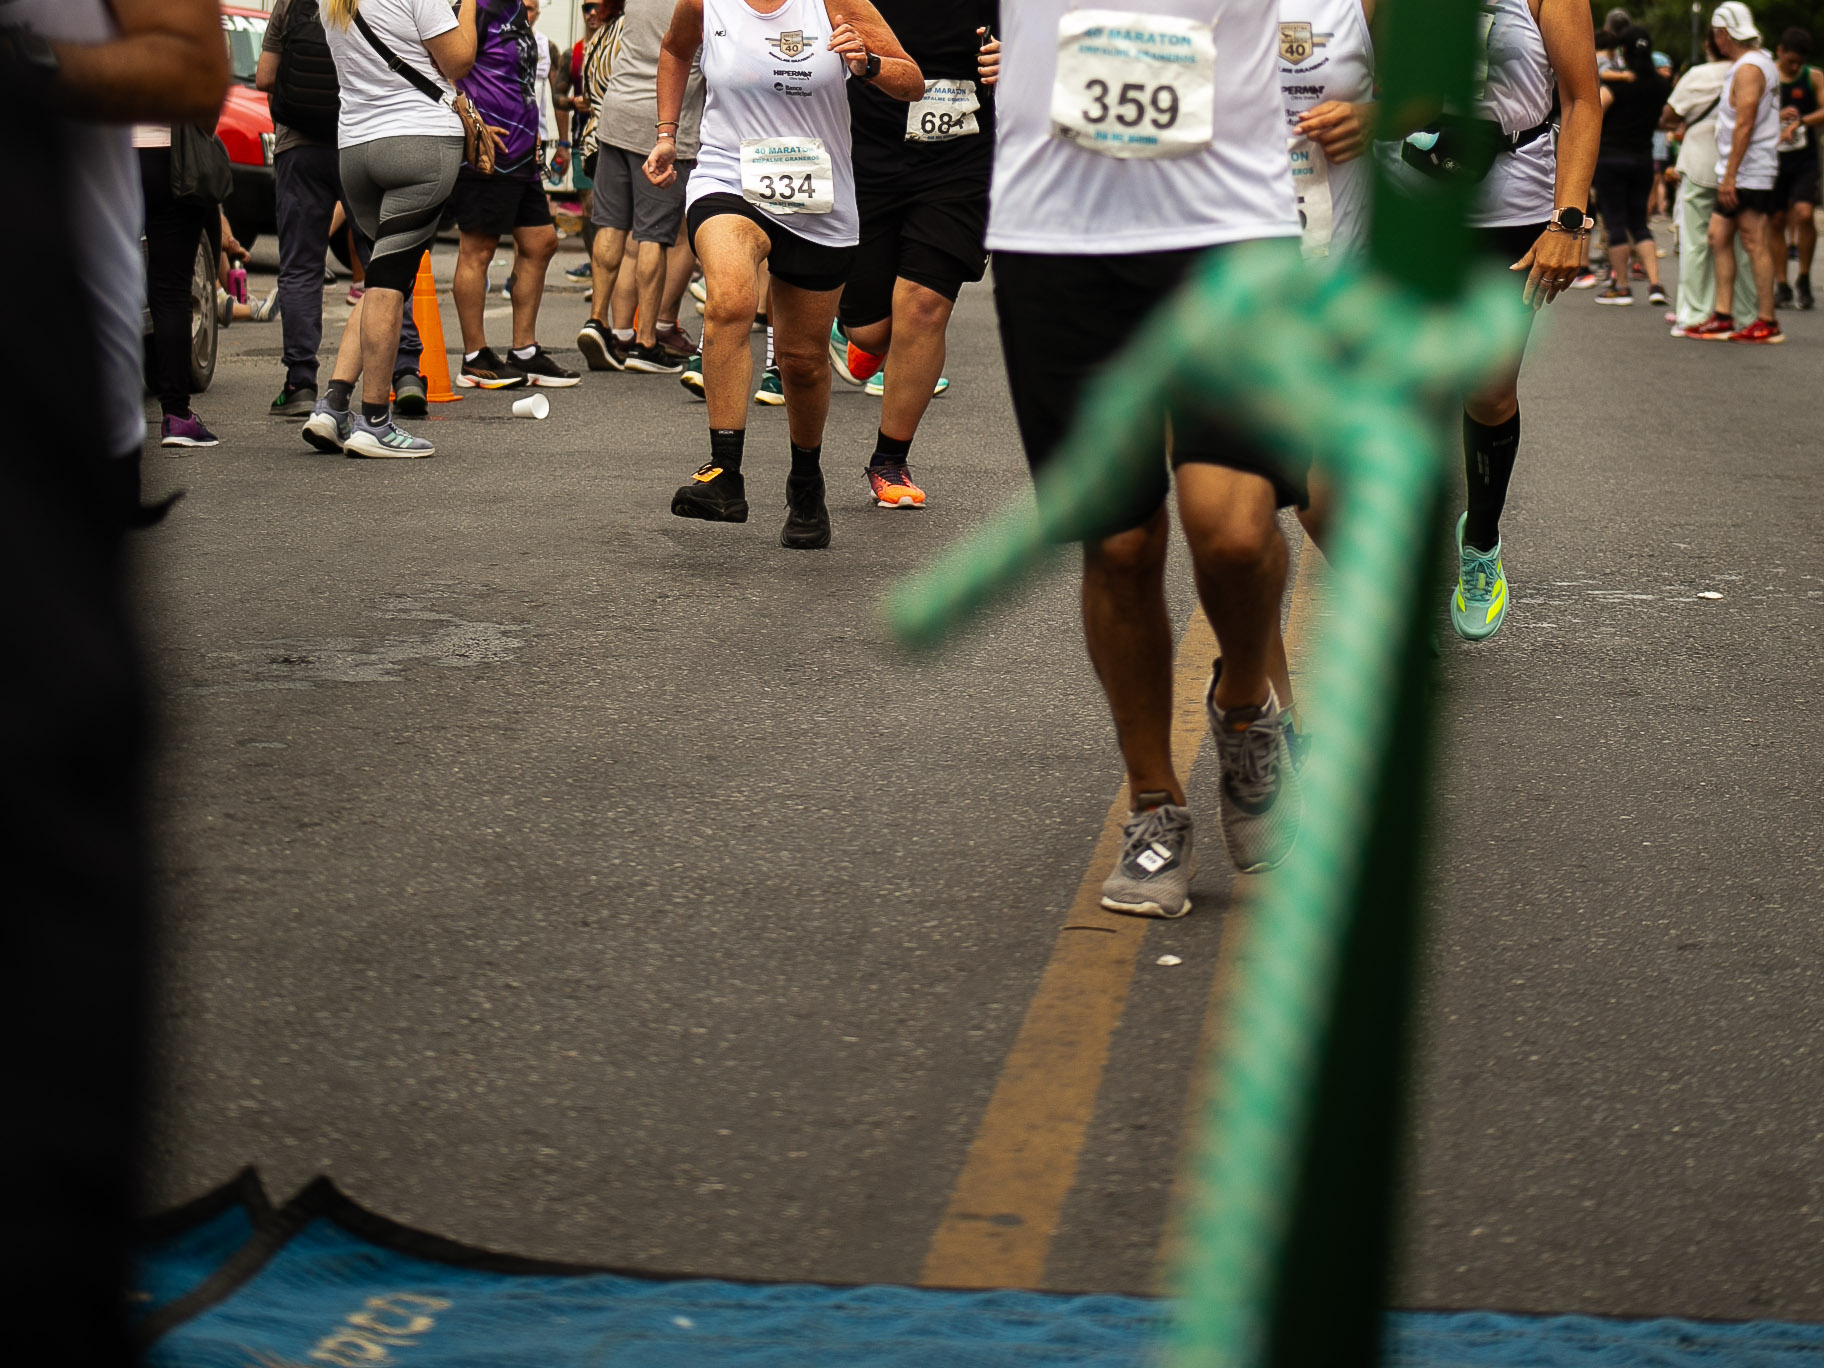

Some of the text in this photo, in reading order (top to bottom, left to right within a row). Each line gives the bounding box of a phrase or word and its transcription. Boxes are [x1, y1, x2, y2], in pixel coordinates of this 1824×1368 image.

[1107, 28, 1192, 47] MARATON
[1285, 44, 1306, 56] 40
[1082, 79, 1179, 130] 359
[759, 173, 816, 200] 334
